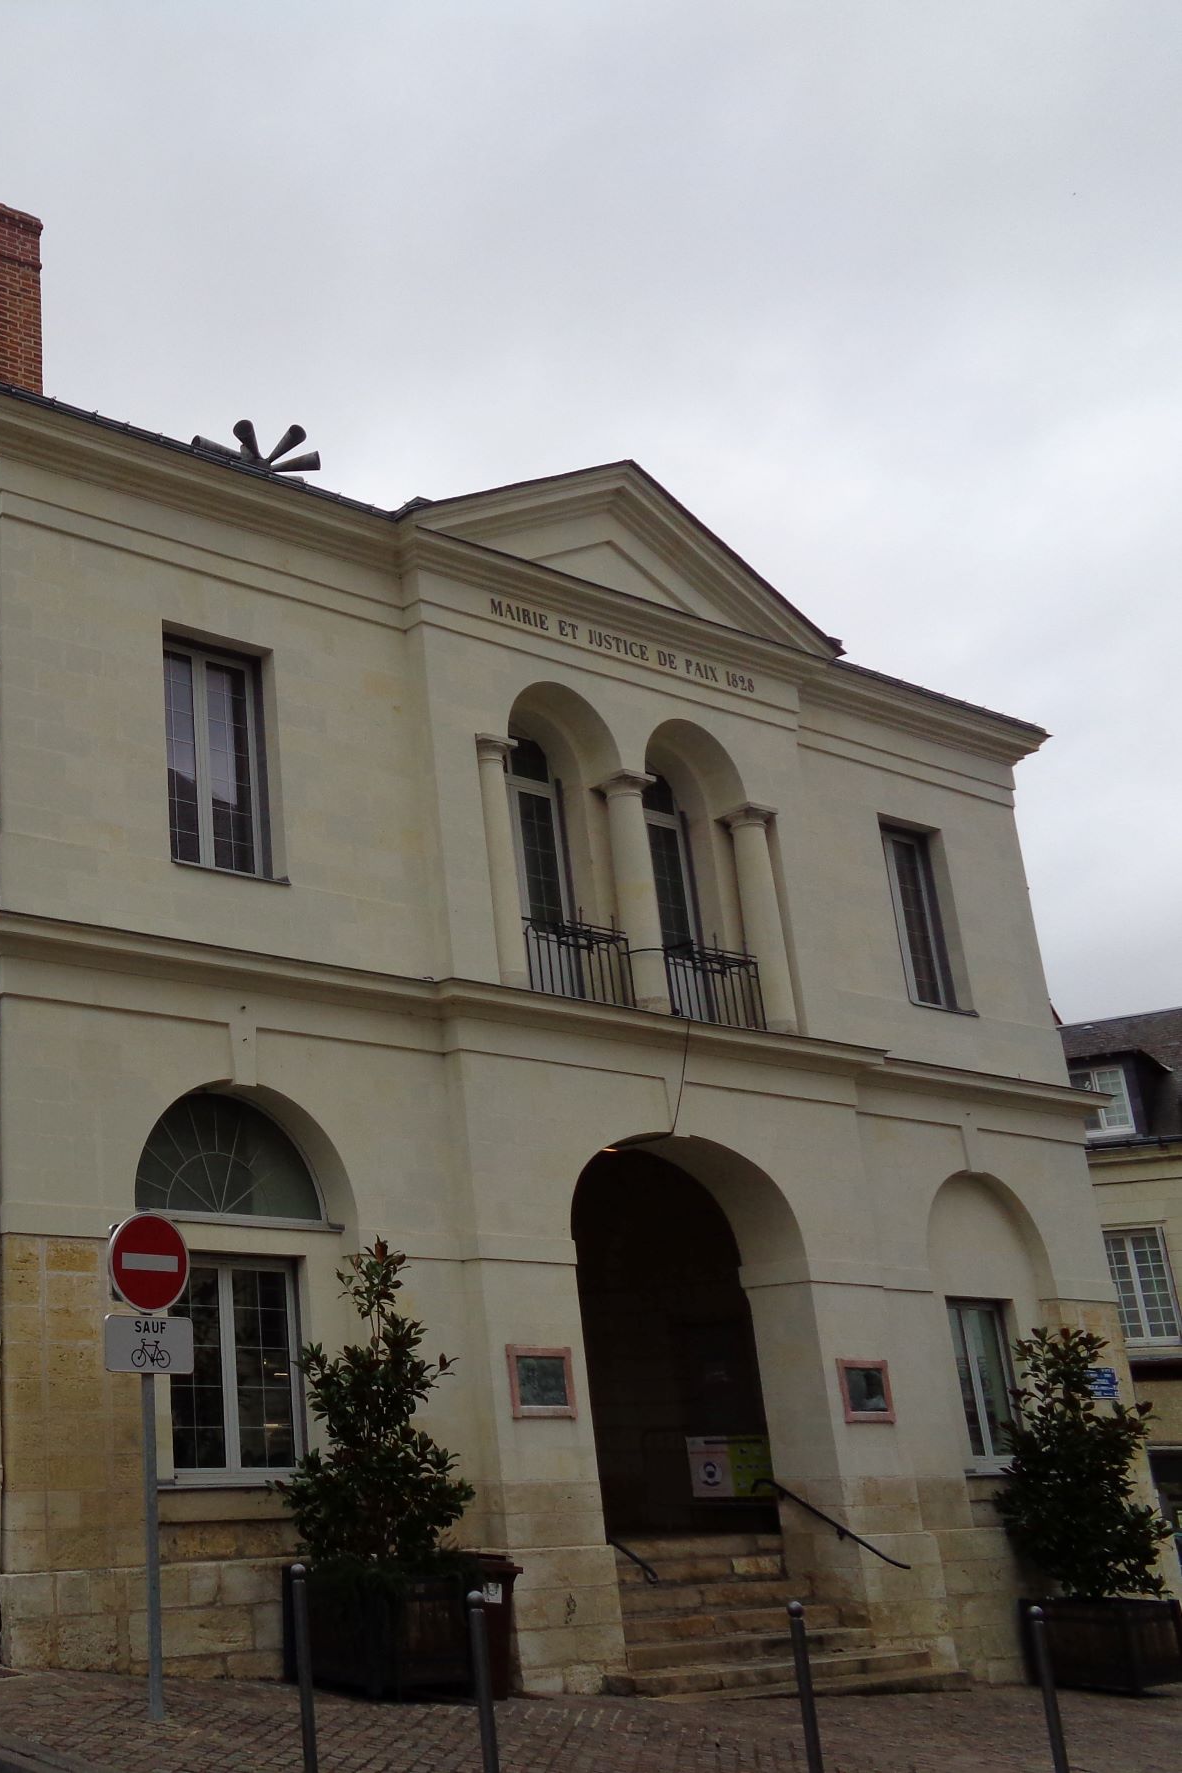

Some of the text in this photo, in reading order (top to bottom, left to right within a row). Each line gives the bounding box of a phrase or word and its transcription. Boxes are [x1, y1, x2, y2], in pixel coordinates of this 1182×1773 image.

[490, 598, 549, 631] MAIRIE
[558, 619, 579, 640] ET
[657, 650, 678, 671] DE
[685, 658, 719, 682] PAIX
[725, 670, 755, 694] 1828
[134, 1320, 166, 1334] SAUF
